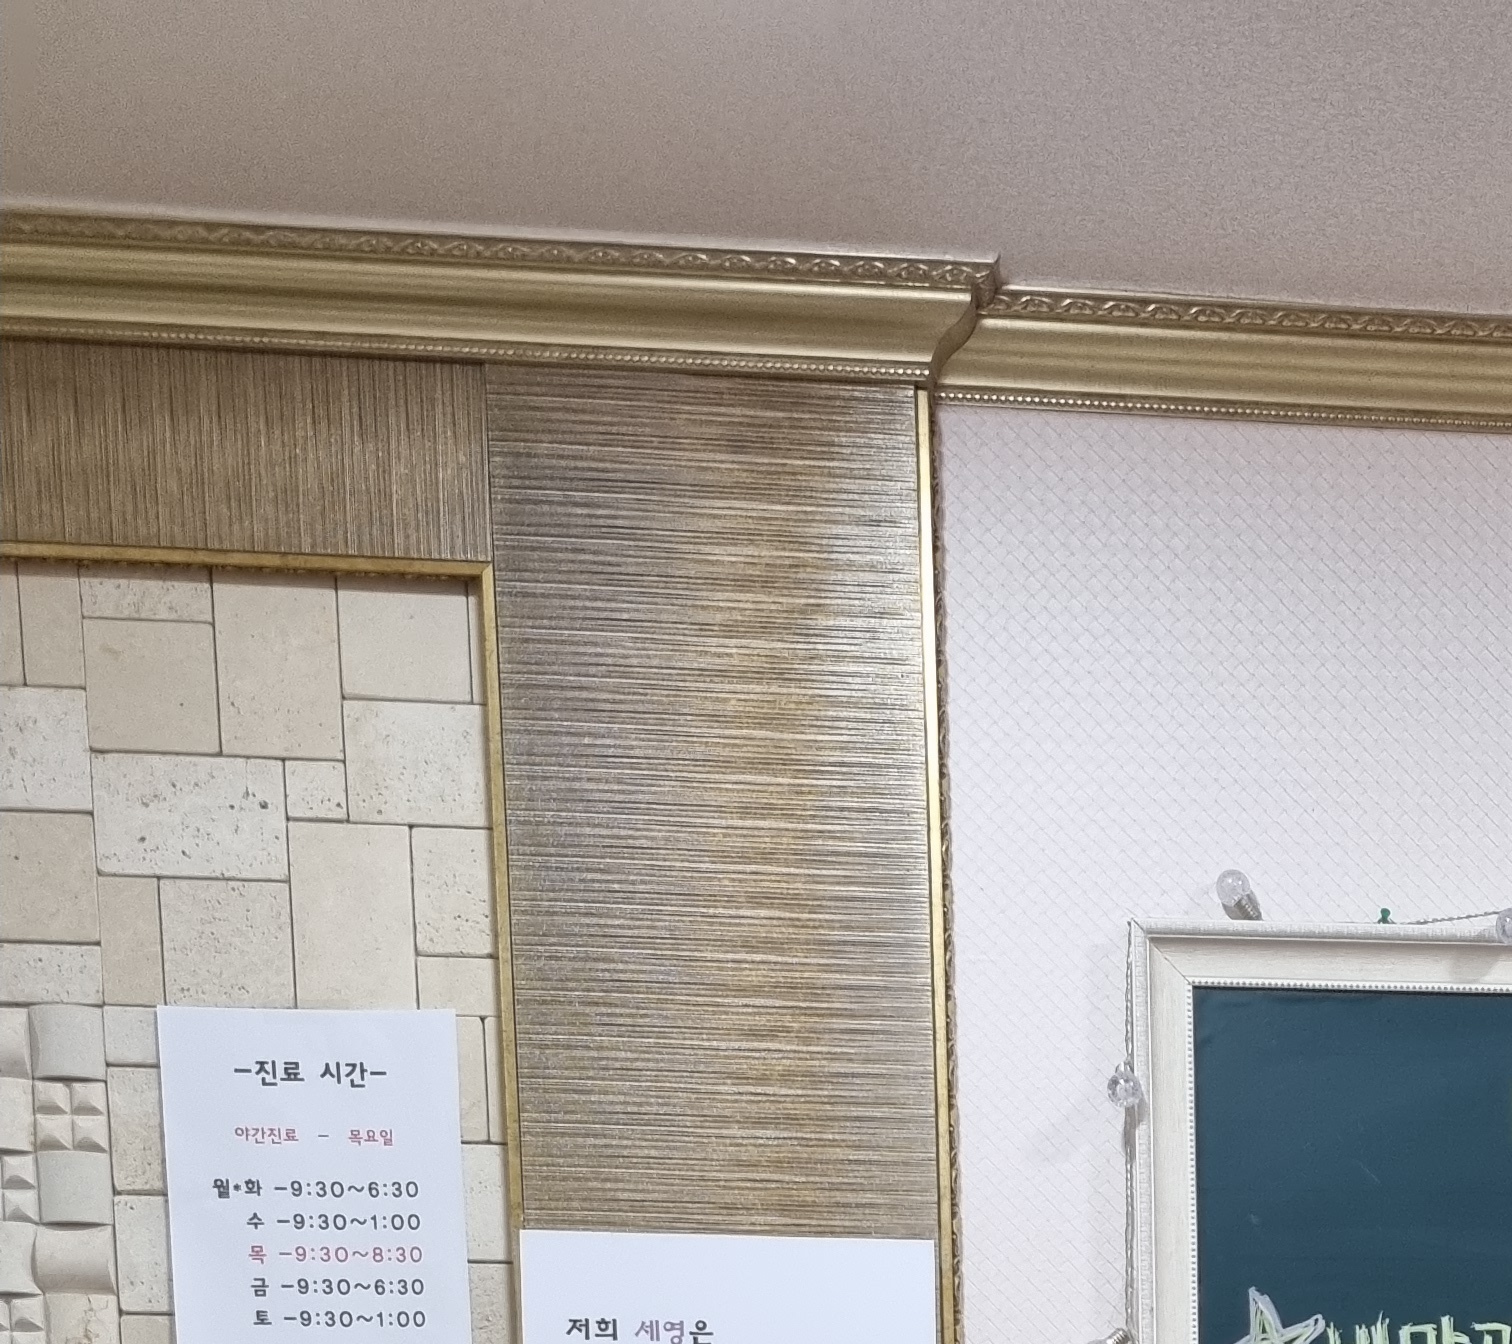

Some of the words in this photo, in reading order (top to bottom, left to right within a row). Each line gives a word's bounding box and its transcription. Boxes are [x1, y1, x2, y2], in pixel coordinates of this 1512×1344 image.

[234, 1127, 299, 1146] 야간진료
[348, 1127, 394, 1146] 목요일
[246, 1213, 265, 1231] 수
[249, 1245, 268, 1264] 목
[250, 1278, 270, 1297] 금
[253, 1310, 272, 1327] 토
[565, 1317, 619, 1342] 저희
